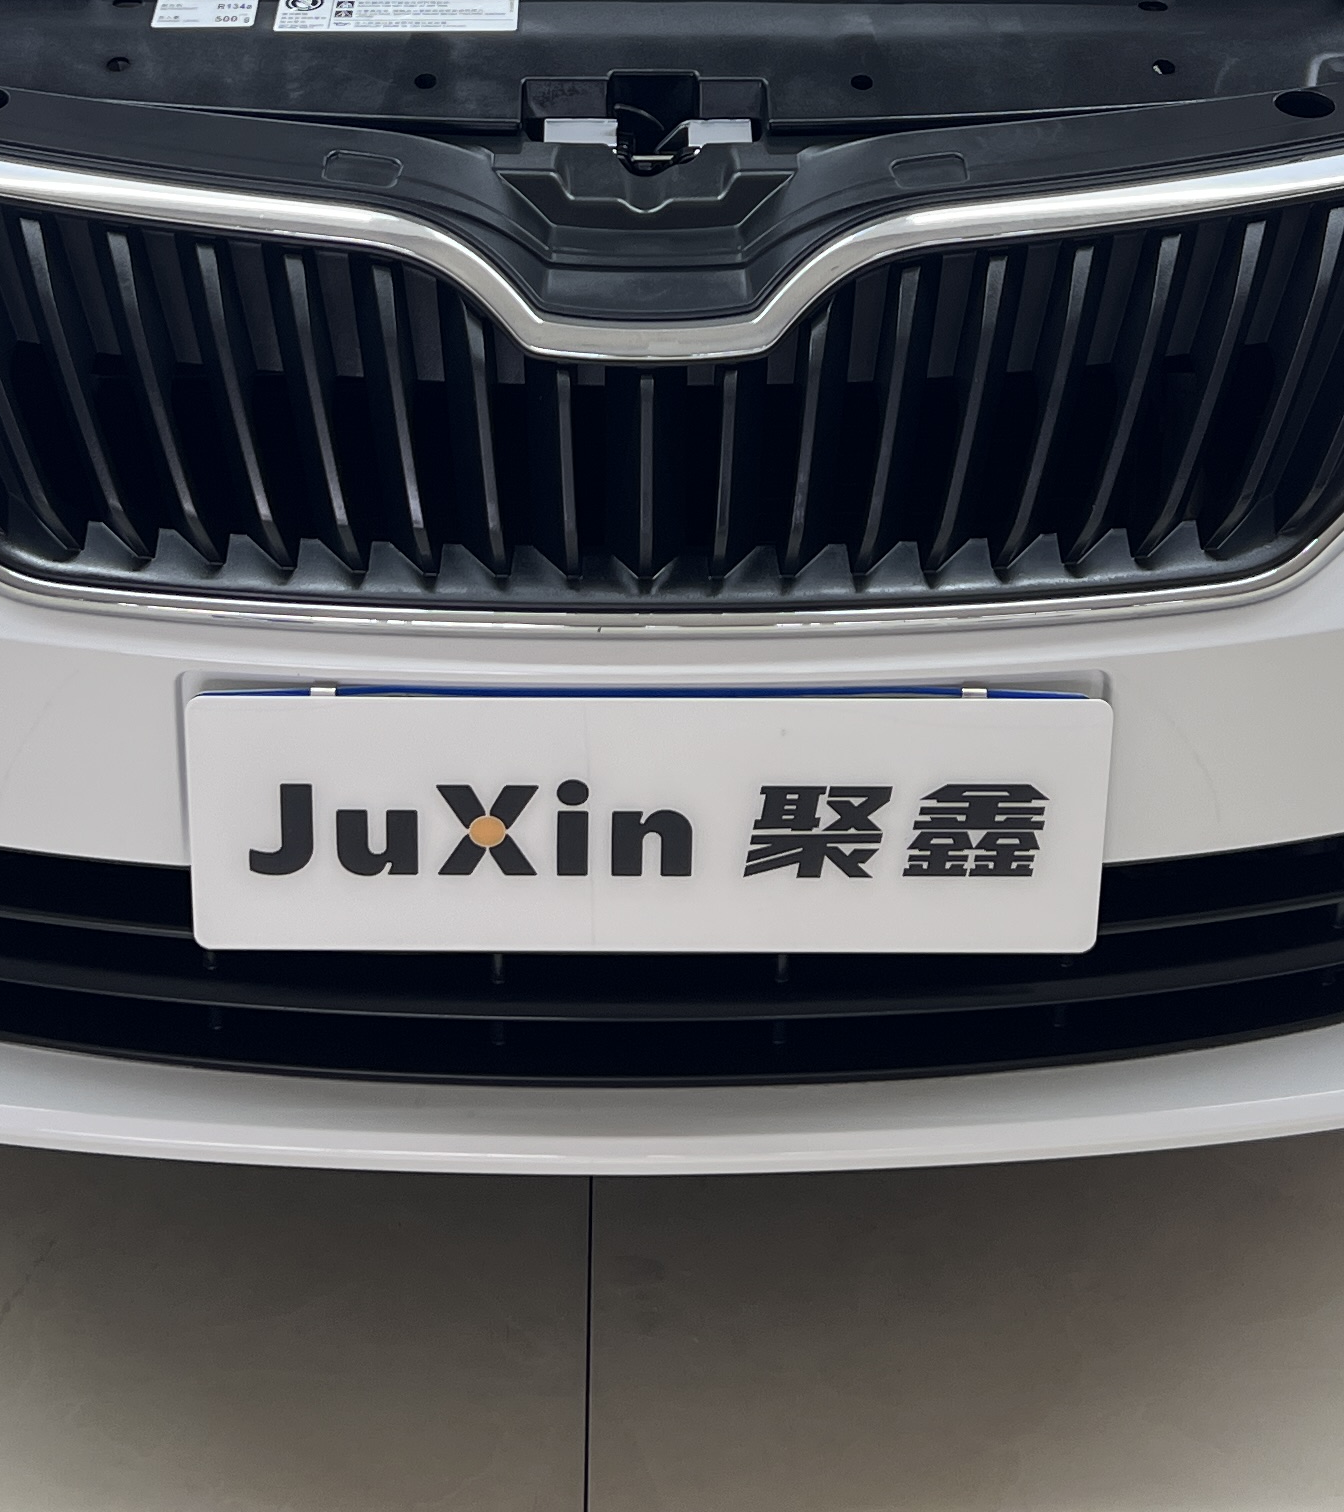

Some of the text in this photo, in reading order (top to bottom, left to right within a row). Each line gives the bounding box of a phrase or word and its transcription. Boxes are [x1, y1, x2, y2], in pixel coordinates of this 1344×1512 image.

[215, 15, 238, 23] 500
[249, 779, 1050, 878] JuXin 聚鑫
